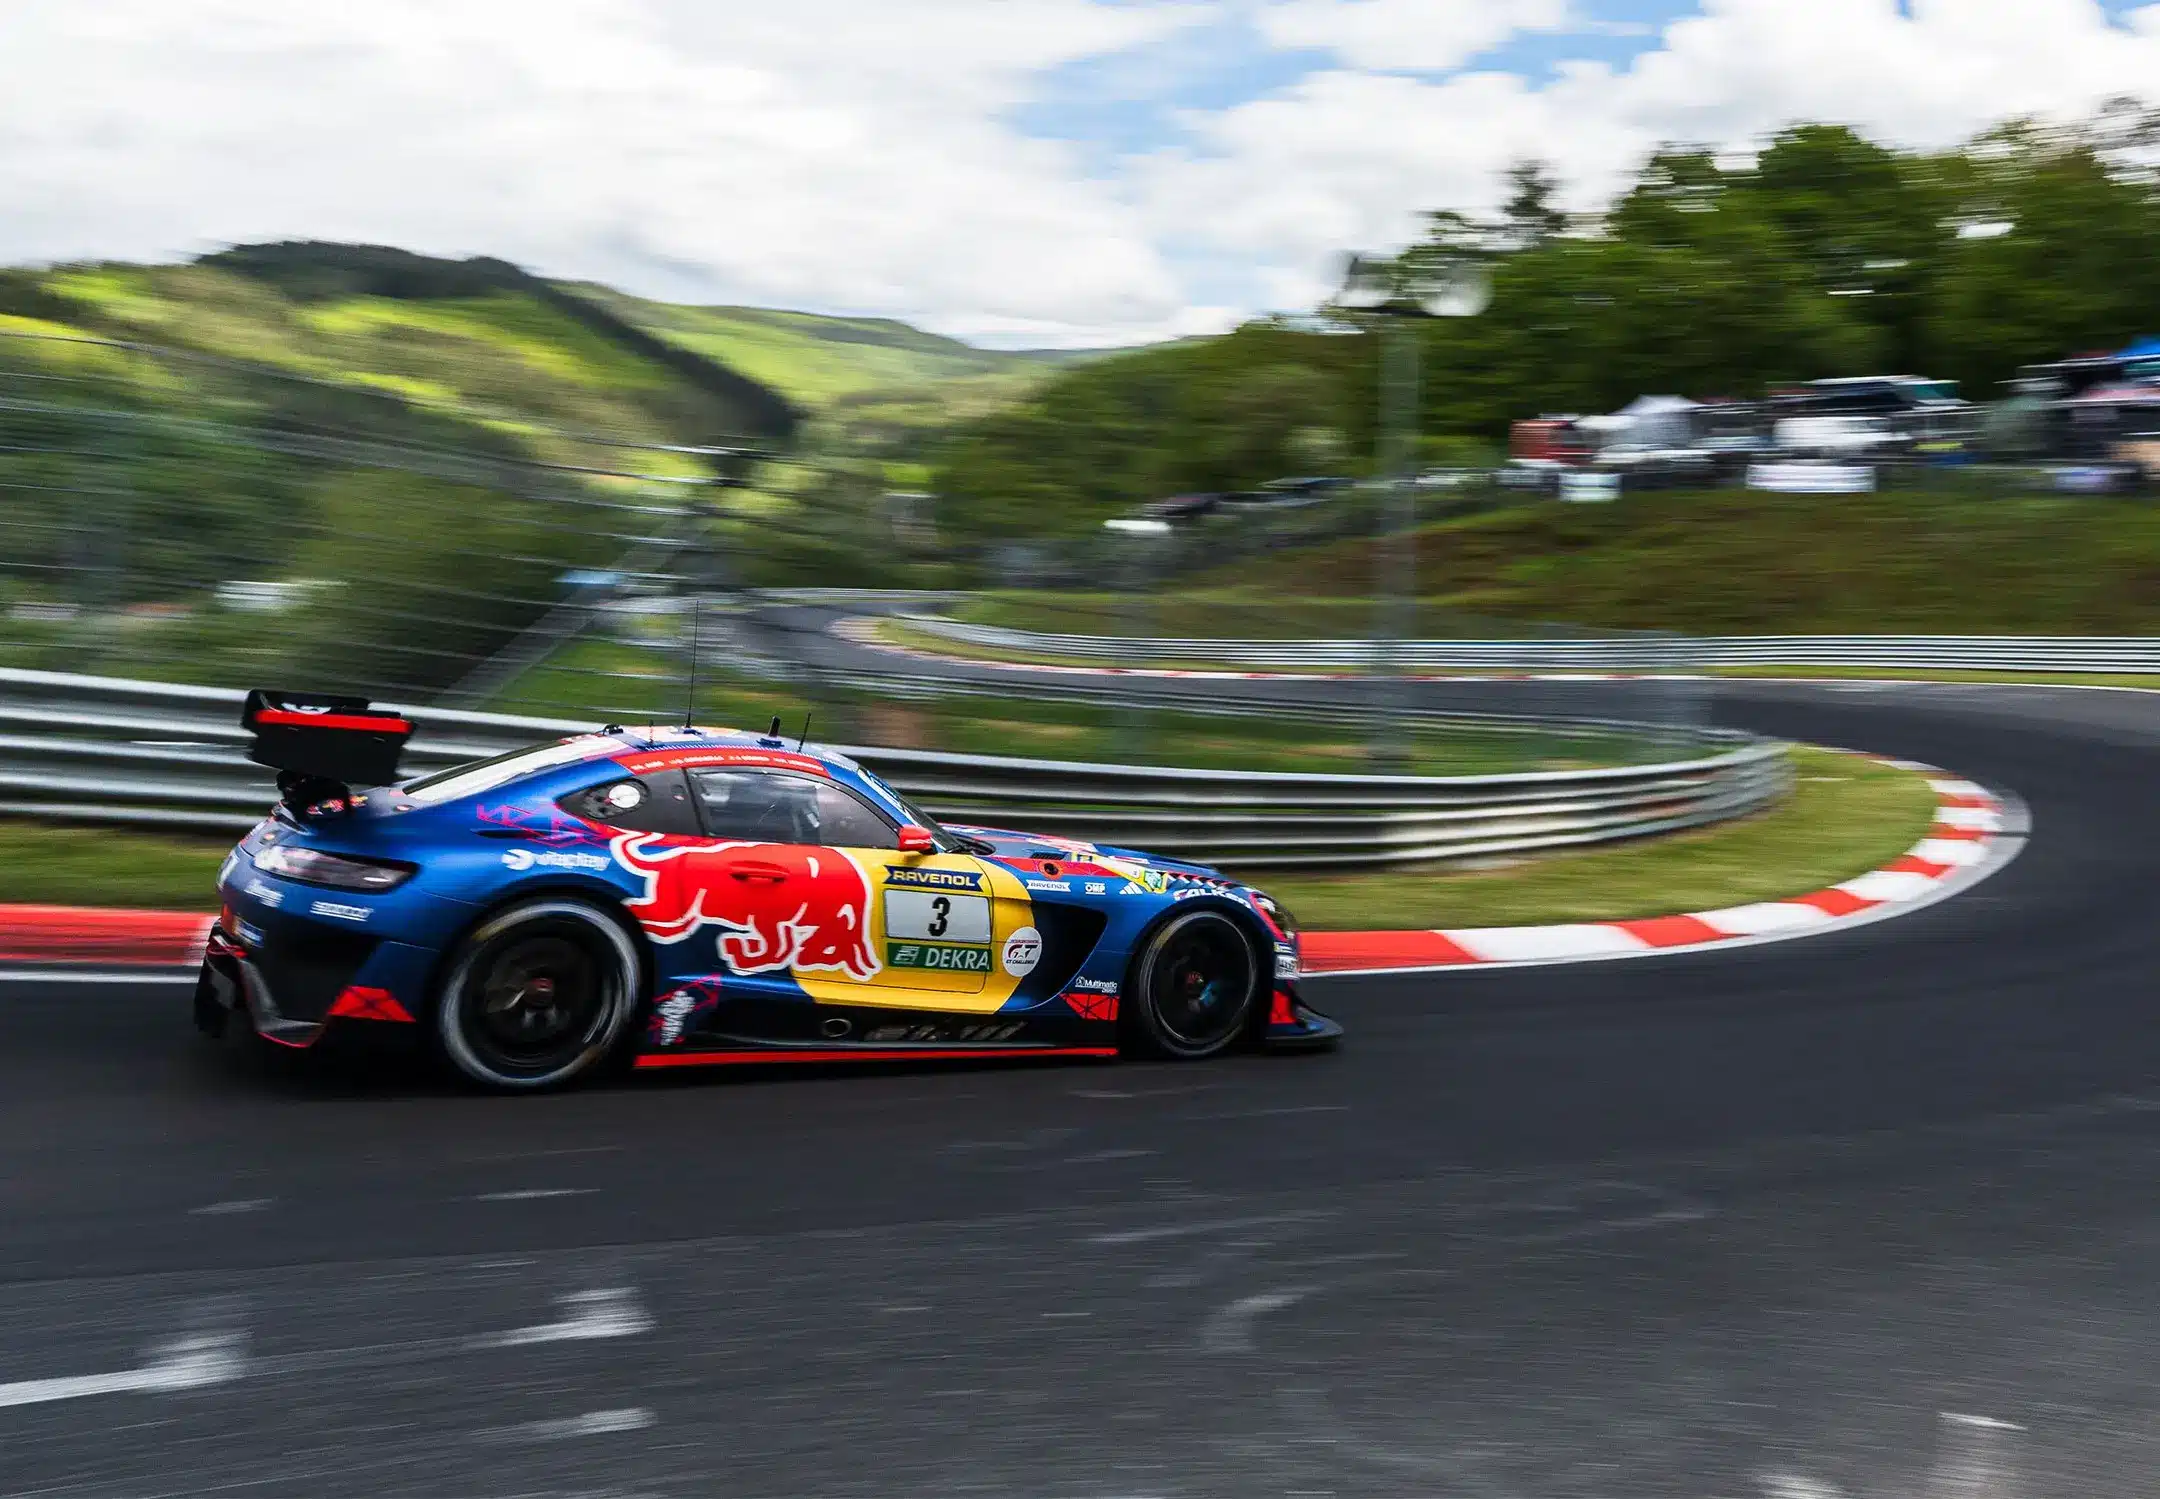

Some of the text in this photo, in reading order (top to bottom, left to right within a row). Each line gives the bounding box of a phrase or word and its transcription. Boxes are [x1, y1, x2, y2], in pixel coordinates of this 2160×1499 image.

[893, 870, 975, 887] RAVENOL
[1030, 882, 1067, 890] RAVENOL
[928, 896, 951, 937] 3
[925, 947, 990, 970] DEKRA
